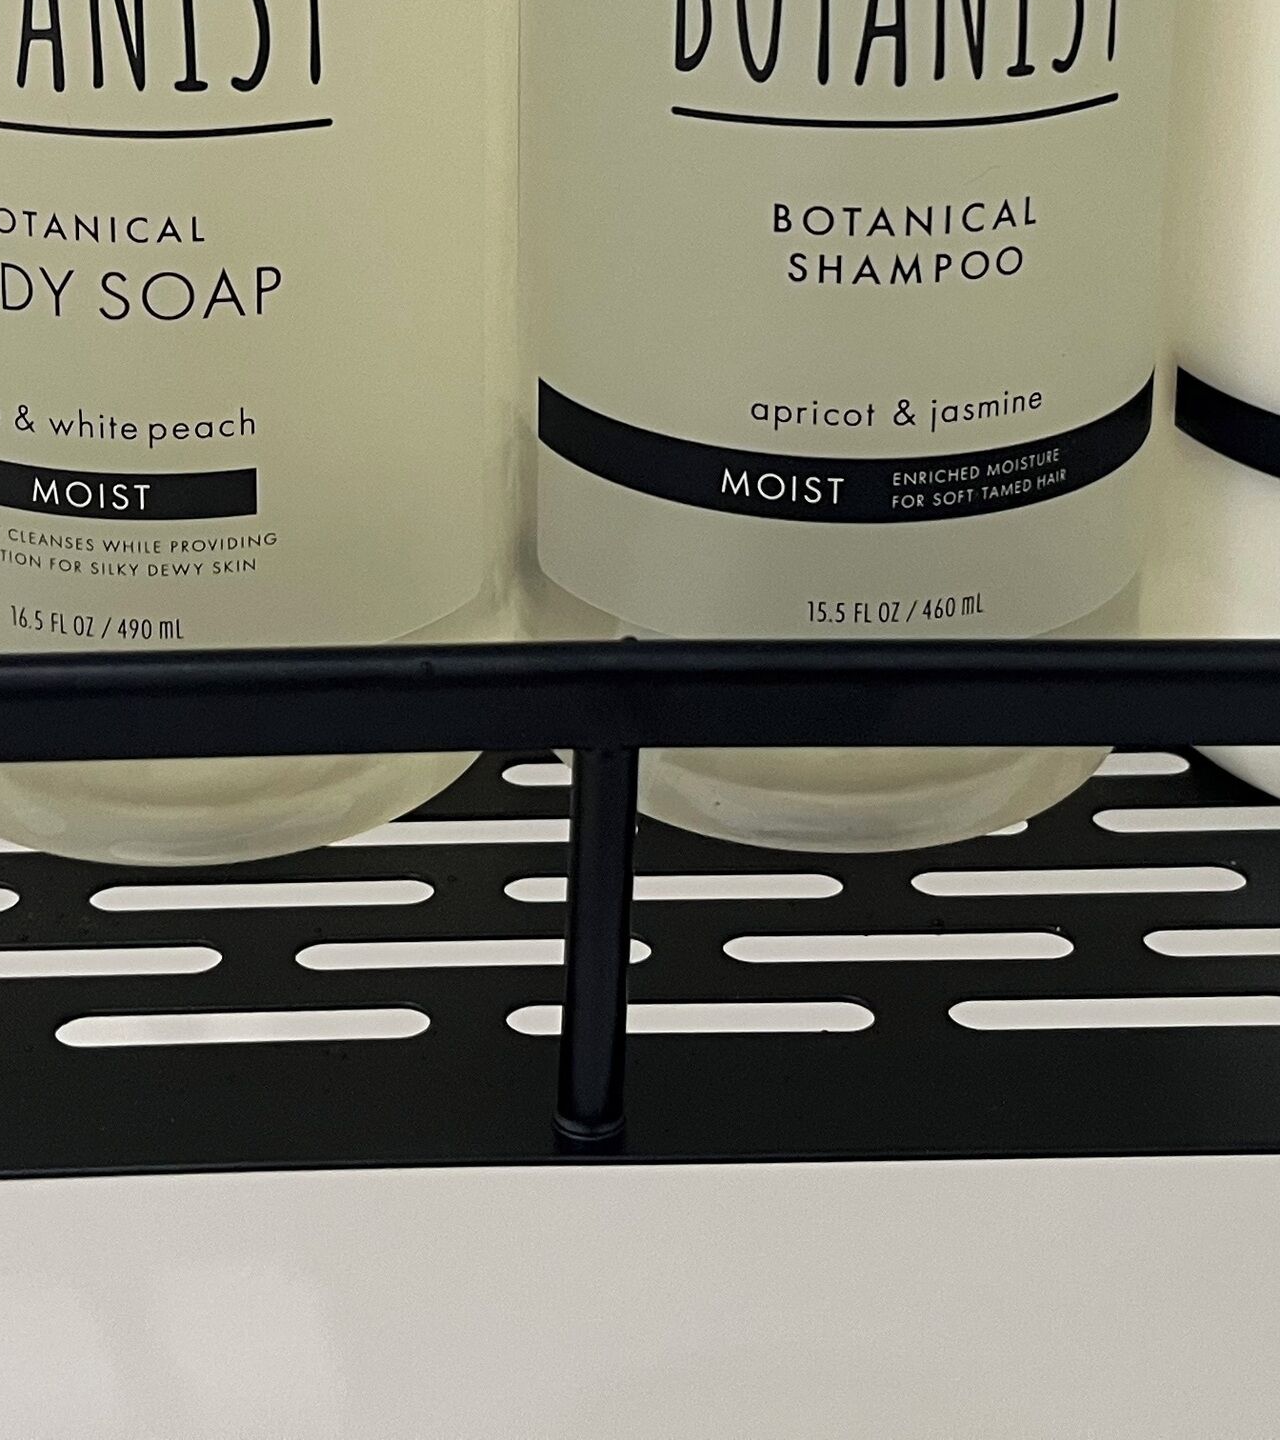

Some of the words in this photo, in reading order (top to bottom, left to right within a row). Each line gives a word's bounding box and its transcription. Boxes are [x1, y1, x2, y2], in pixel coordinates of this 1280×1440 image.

[773, 196, 1037, 237] BOTANICAL
[787, 245, 1023, 285] SHAMPOO
[98, 266, 282, 321] SOAP
[14, 404, 36, 433] &
[48, 408, 138, 440] white
[148, 406, 255, 449] peach
[750, 400, 875, 431] apricot
[893, 398, 916, 426] &
[931, 390, 1042, 433] jasmine
[721, 467, 845, 505] MOIST
[892, 465, 980, 487] ENRICHED
[986, 448, 1059, 476] MOISTURE
[32, 477, 151, 511] MOIST
[892, 494, 925, 509] FOR
[932, 488, 974, 507] SOFT
[981, 478, 1032, 500] TAMED
[1036, 468, 1067, 490] HAIR
[7, 528, 95, 552] CLEANSES
[102, 539, 161, 554] WHILE
[170, 532, 277, 553] PROVIDING
[49, 557, 82, 573] FOR
[90, 561, 139, 577] SILKY
[147, 563, 203, 577] DEWY
[212, 558, 256, 575] SKIN
[10, 604, 44, 631] 16.5
[50, 612, 68, 635] FL
[73, 615, 94, 638] OZ
[117, 618, 152, 640] 490
[159, 618, 184, 640] mL
[807, 600, 845, 623] 15.5
[854, 602, 872, 624] FL
[878, 601, 900, 623] OZ
[922, 597, 956, 620] 460
[961, 592, 984, 616] mL
